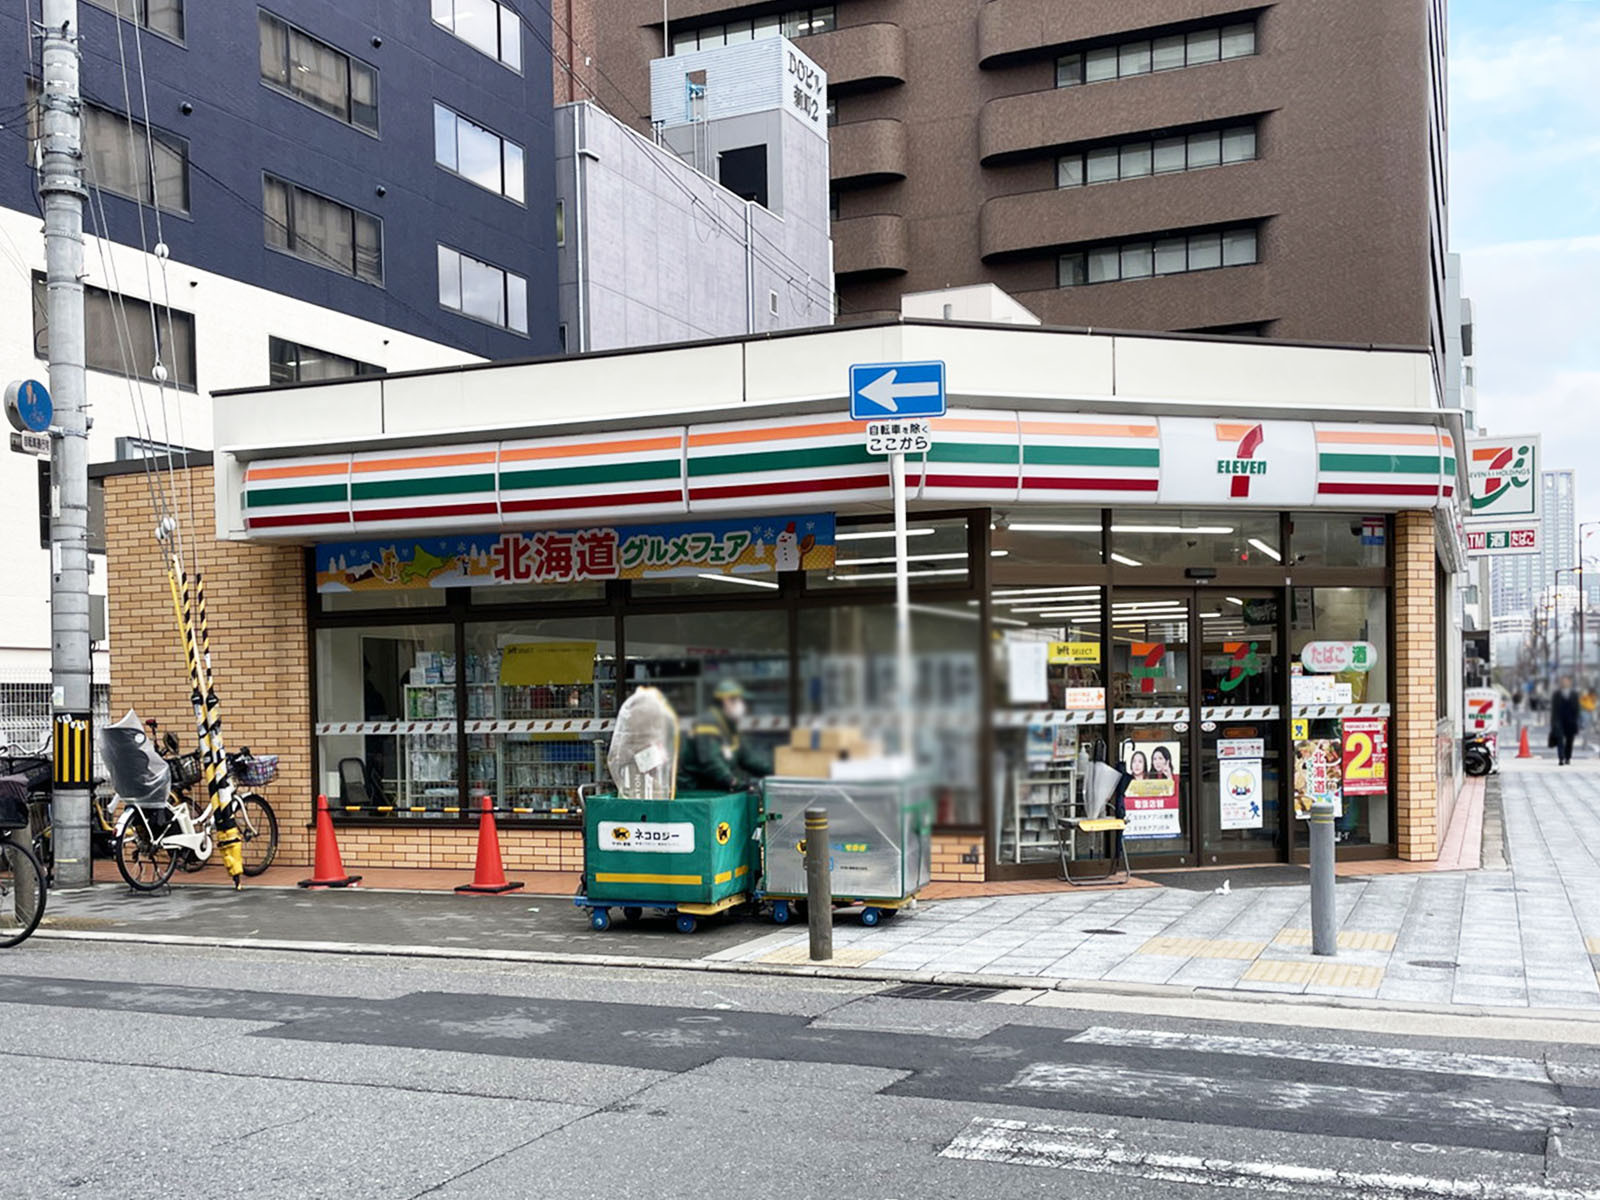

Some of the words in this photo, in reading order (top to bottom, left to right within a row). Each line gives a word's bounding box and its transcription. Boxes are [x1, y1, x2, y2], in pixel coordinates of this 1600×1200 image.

[870, 436, 928, 451] ここから
[1490, 532, 1506, 547] 酒
[1511, 530, 1534, 547] たばこ
[493, 529, 618, 581] 北海道
[1311, 646, 1346, 664] たばこ
[1352, 645, 1367, 663] 酒
[635, 828, 680, 841] ネコロジー
